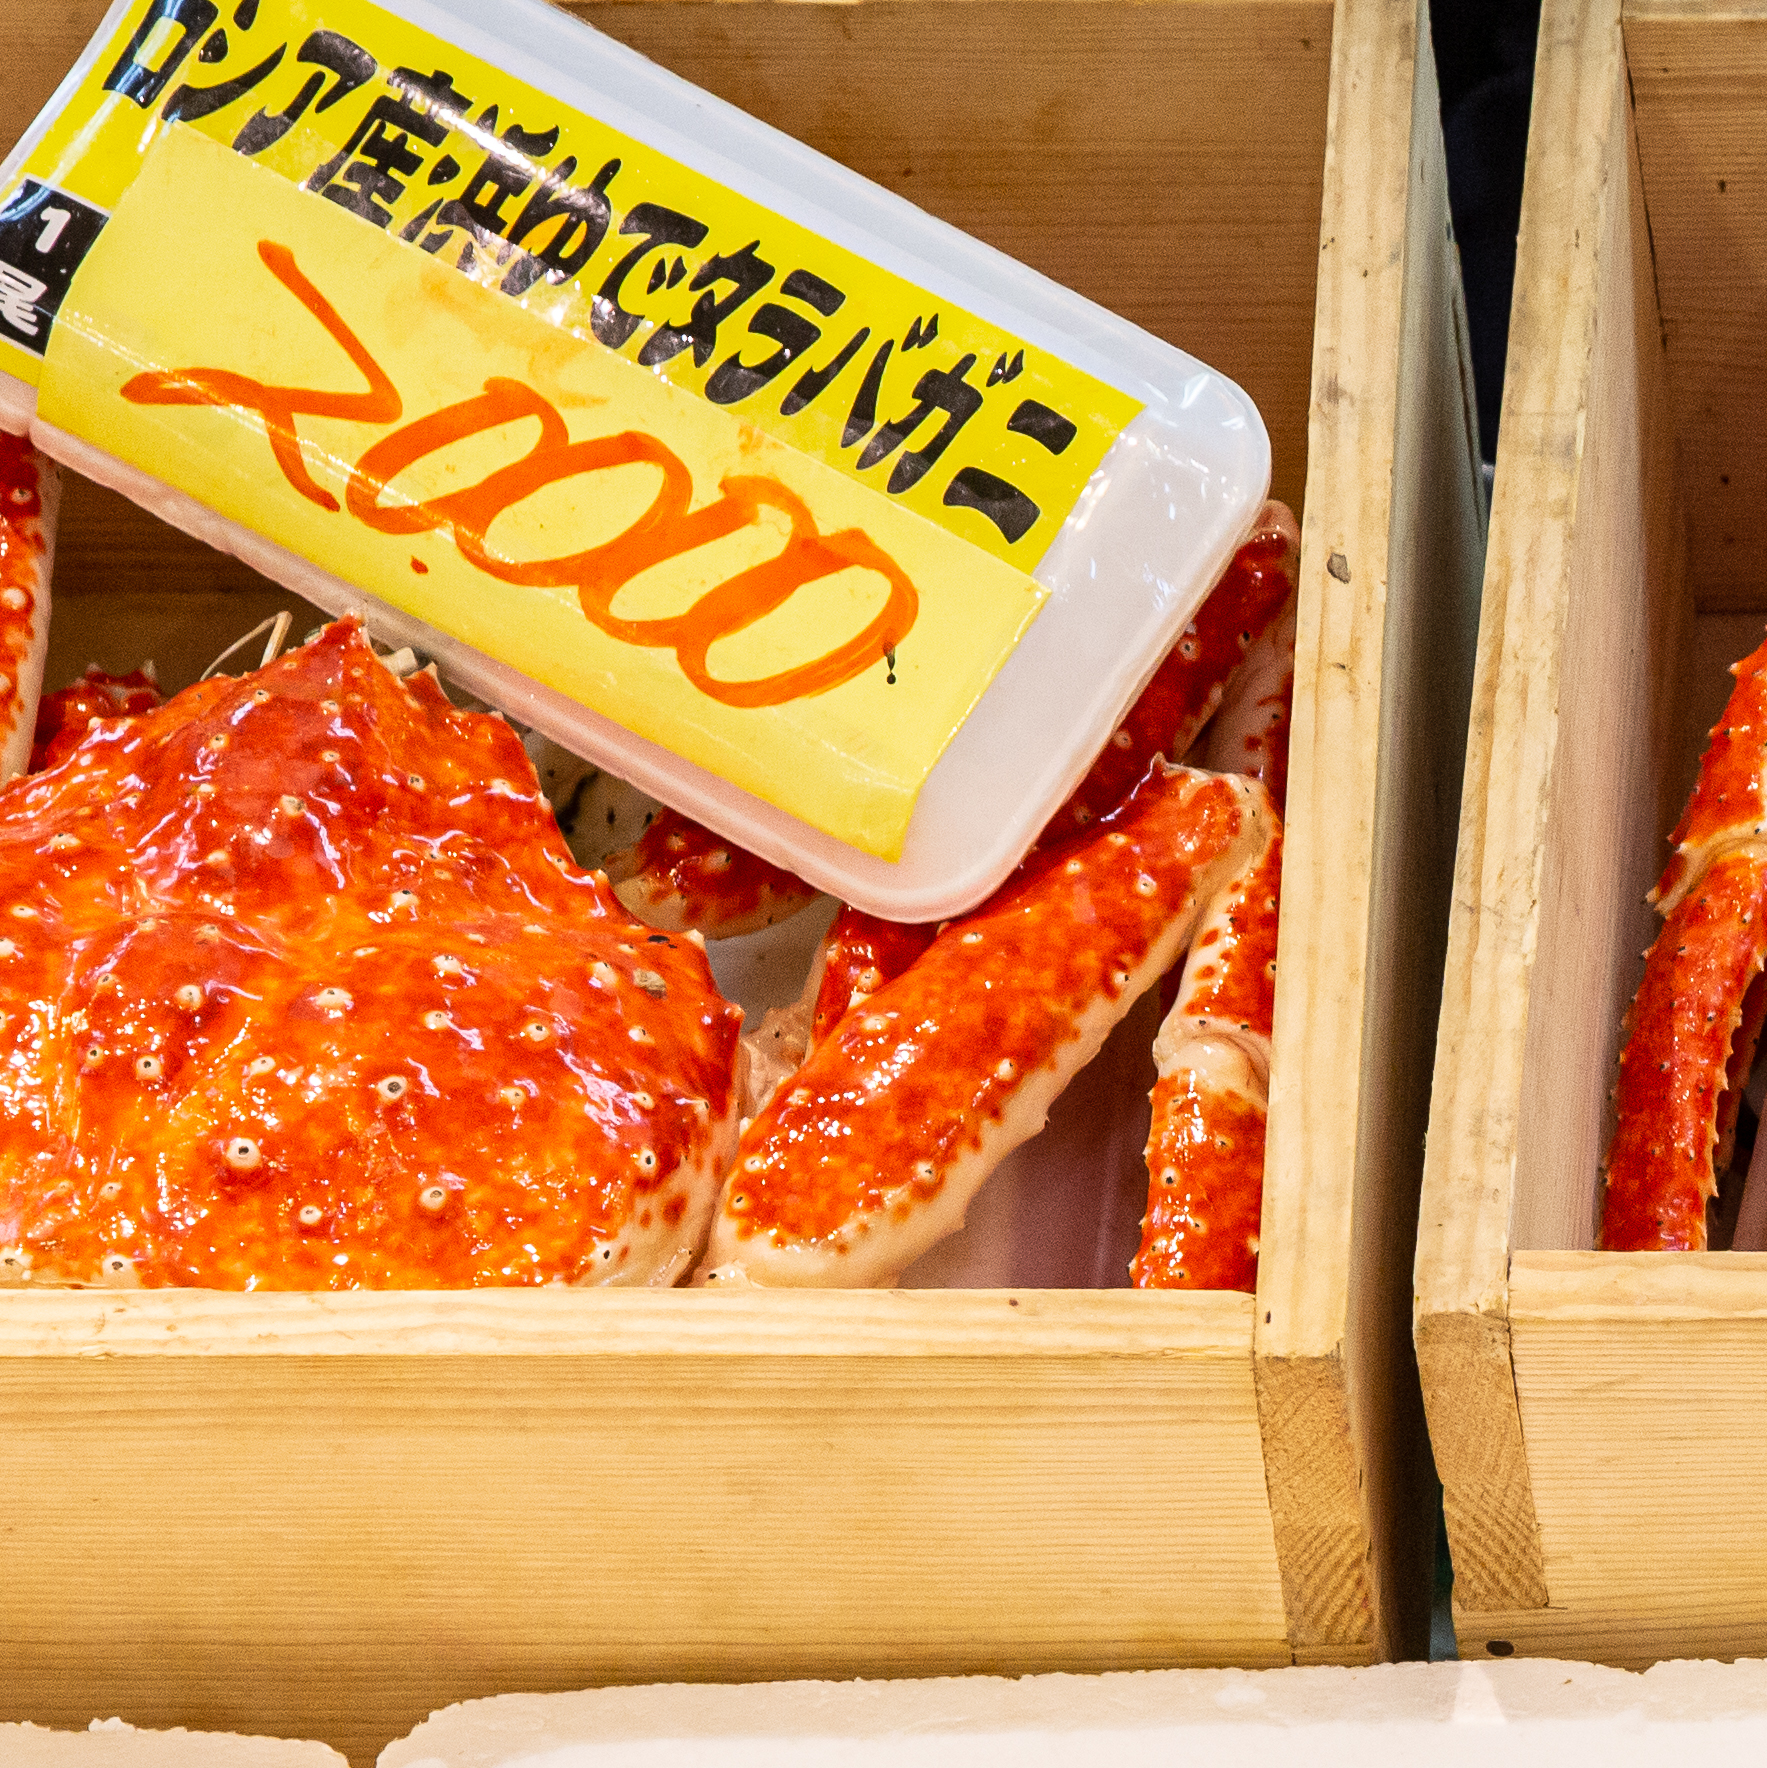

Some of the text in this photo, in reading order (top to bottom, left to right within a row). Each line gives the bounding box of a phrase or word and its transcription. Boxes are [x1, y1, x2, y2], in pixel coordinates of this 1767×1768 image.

[103, 0, 1078, 543] ロシア産浜ゆでタラバガニ
